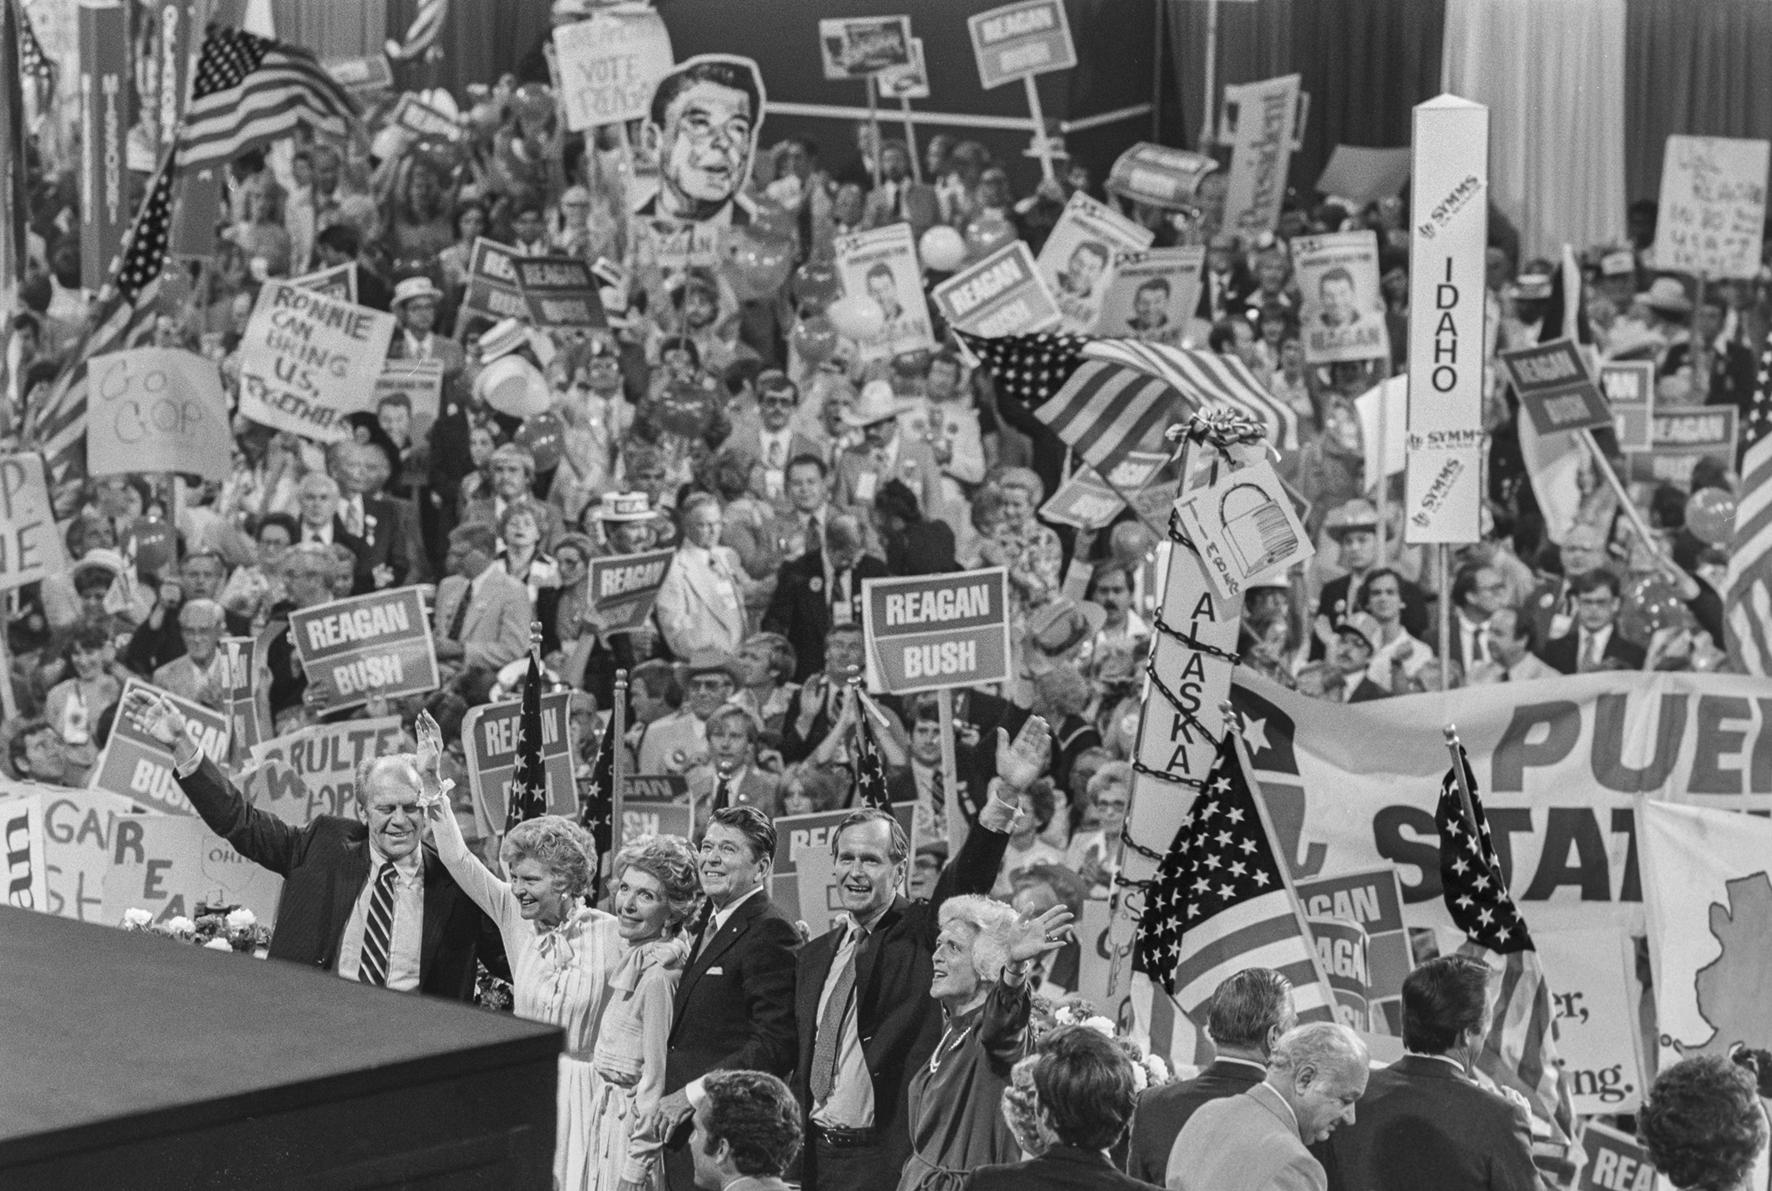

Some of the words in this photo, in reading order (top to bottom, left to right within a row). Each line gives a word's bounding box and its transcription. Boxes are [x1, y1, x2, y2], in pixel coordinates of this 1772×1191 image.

[1431, 174, 1478, 219] SYMMS
[948, 256, 1023, 316] REAGAN
[271, 310, 313, 341] CAN
[273, 285, 374, 341] RONNIE
[1431, 257, 1460, 393] IDAHO
[1427, 429, 1475, 443] SYMM
[1421, 459, 1460, 508] SYMMS
[600, 560, 665, 597] REAGAN
[305, 600, 410, 651] REAGAN
[885, 583, 990, 626] REAGAN
[333, 653, 404, 696] BUSH
[904, 639, 977, 679] BUSH
[1165, 591, 1216, 776] ALASKA
[130, 757, 196, 816] BUS
